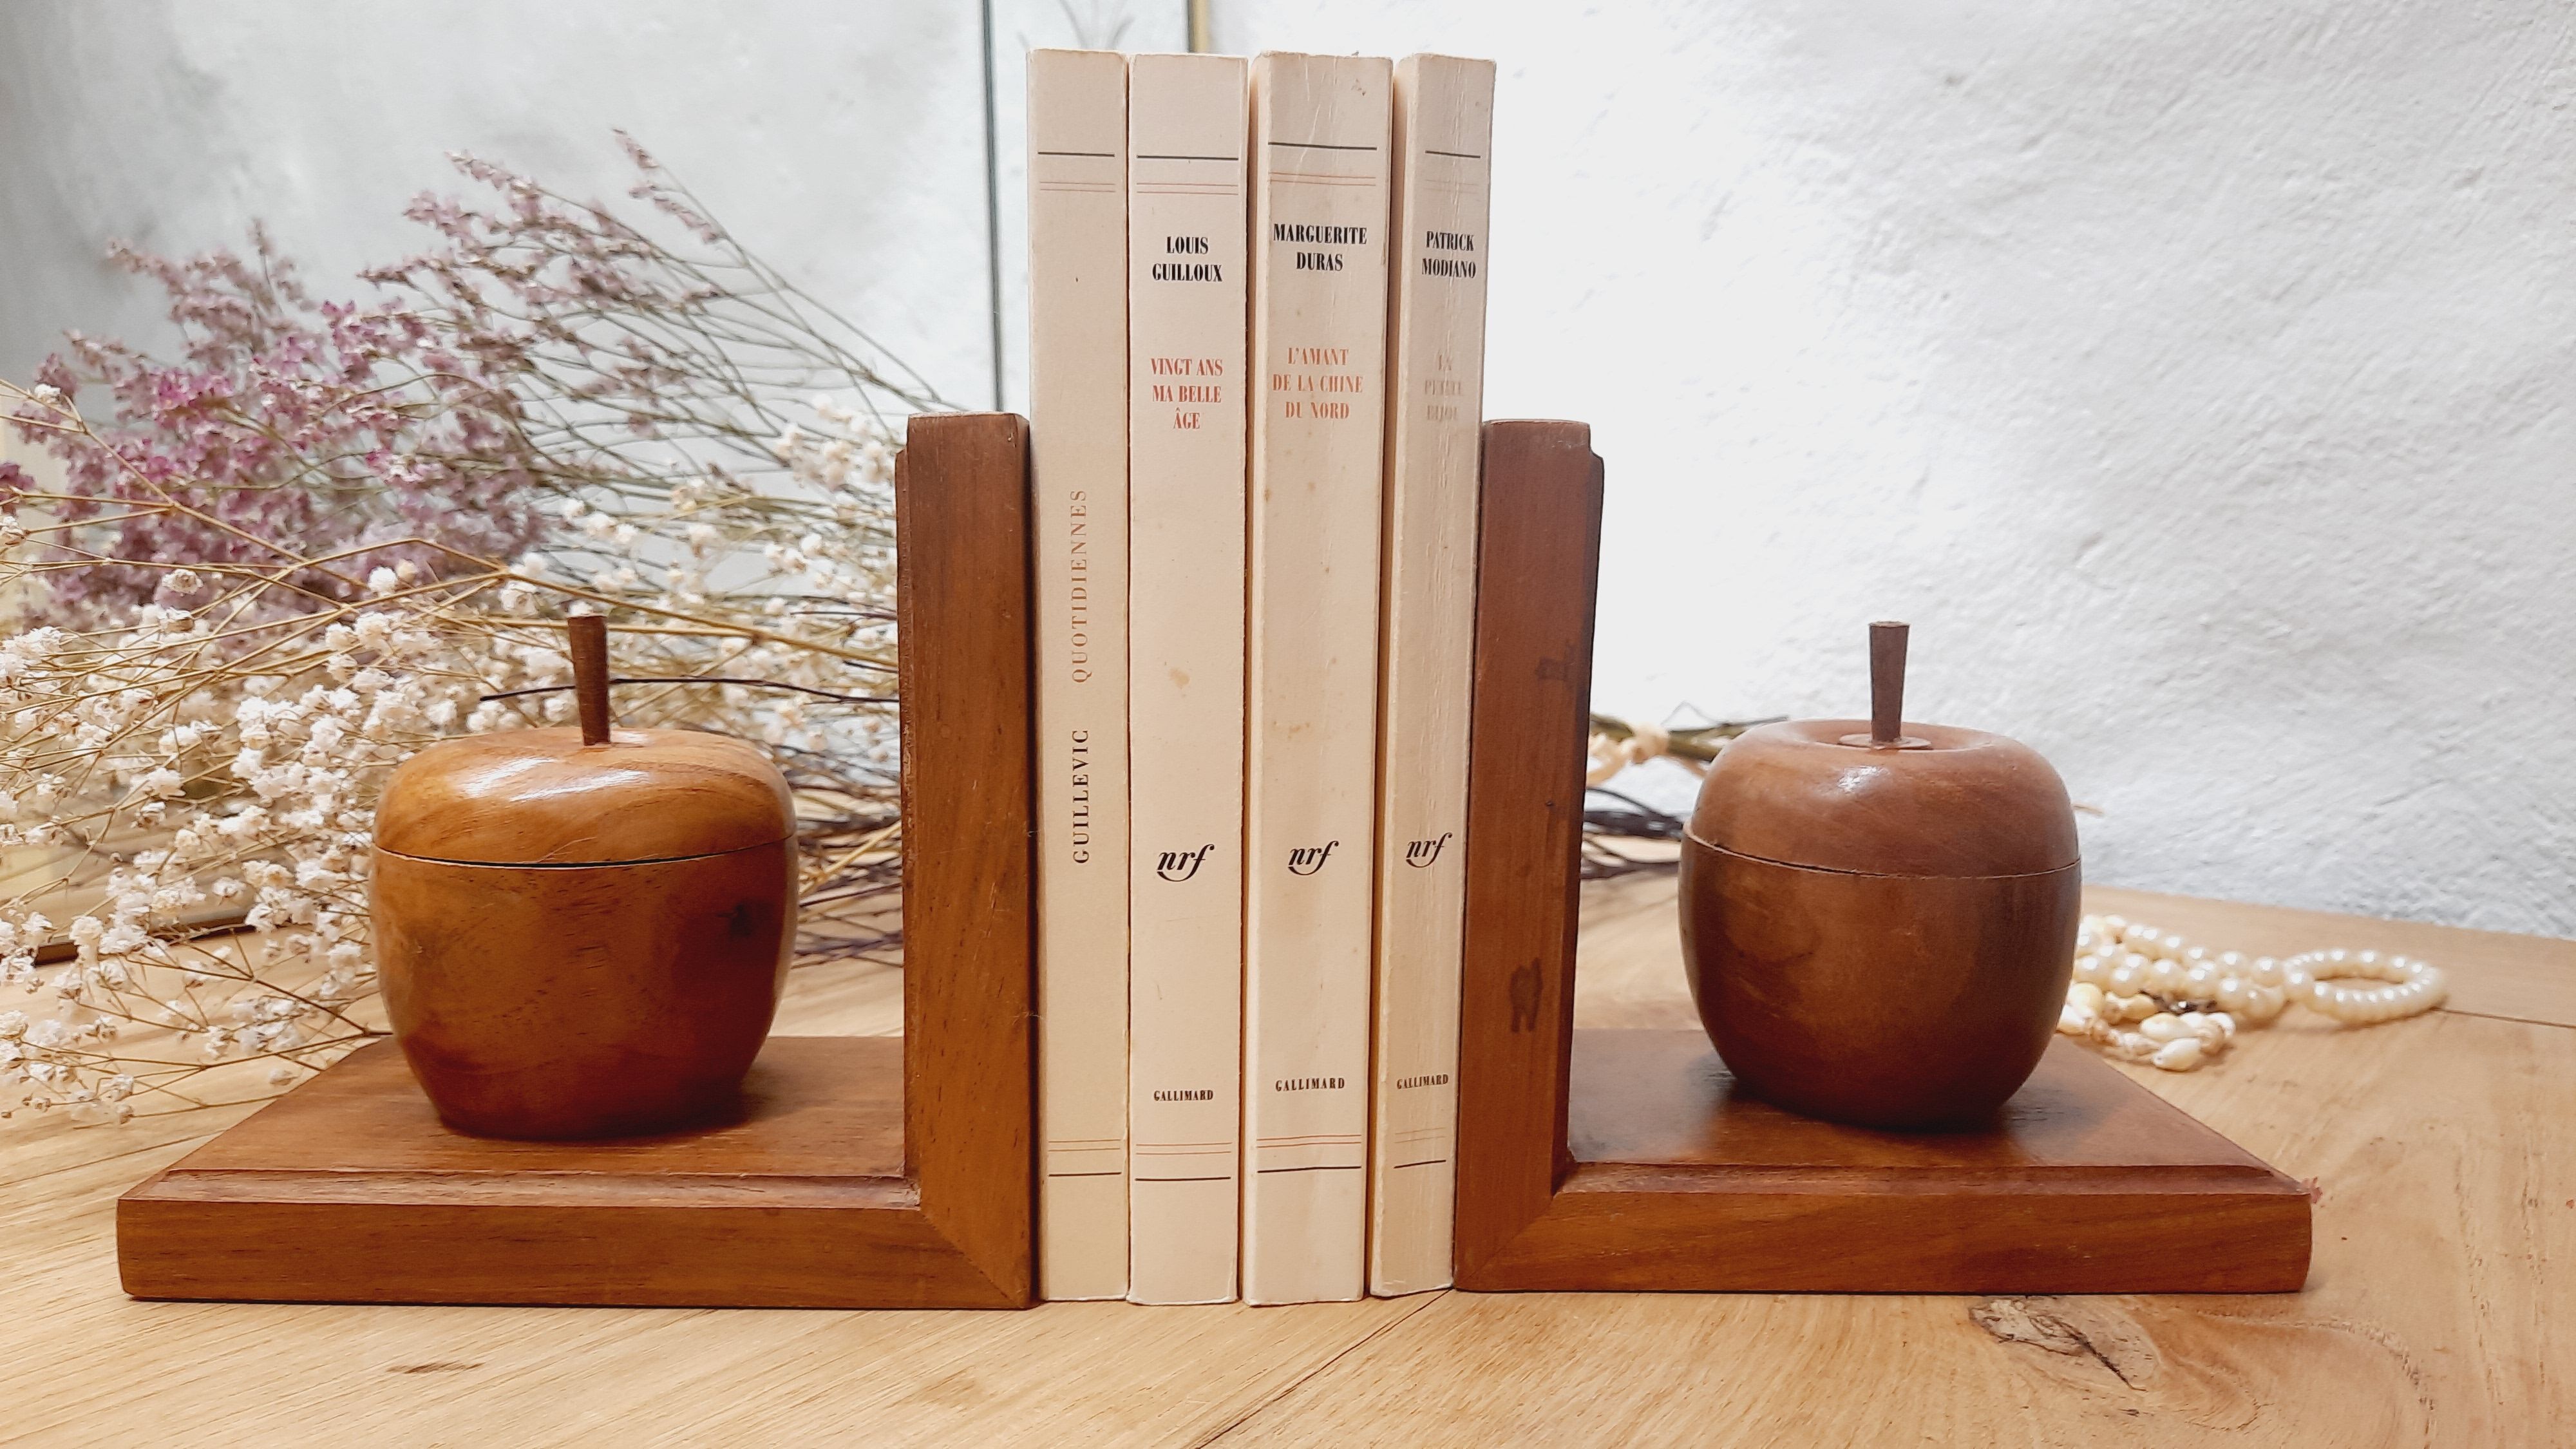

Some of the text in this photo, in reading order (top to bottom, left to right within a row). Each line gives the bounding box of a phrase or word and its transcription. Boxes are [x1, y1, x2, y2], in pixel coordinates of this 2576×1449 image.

[1273, 223, 1367, 245] MARGUERITE
[1426, 231, 1474, 252] PATRICK
[1166, 236, 1209, 255] LOUIS
[1296, 252, 1343, 272] DURAS
[1421, 258, 1476, 279] MODIANO
[1152, 263, 1222, 282] GUILLOUX
[1288, 347, 1349, 366] L'AMANT
[1151, 357, 1224, 377] VINGT ANS
[1153, 384, 1222, 403] MA BELLE
[1273, 374, 1363, 393] DE LA CHINE
[1173, 406, 1200, 430] ÂGE
[1285, 401, 1350, 419] DU NORD
[1070, 491, 1092, 864] GUILLEVIC QUOTIDIENNES
[1287, 840, 1340, 876] nrf
[1405, 832, 1453, 868] nrf
[1157, 844, 1215, 882] nrf
[1275, 1077, 1345, 1092] GALLIMARD
[1396, 1074, 1449, 1090] GALLIMARD
[1153, 1090, 1214, 1101] GALLIMARD
